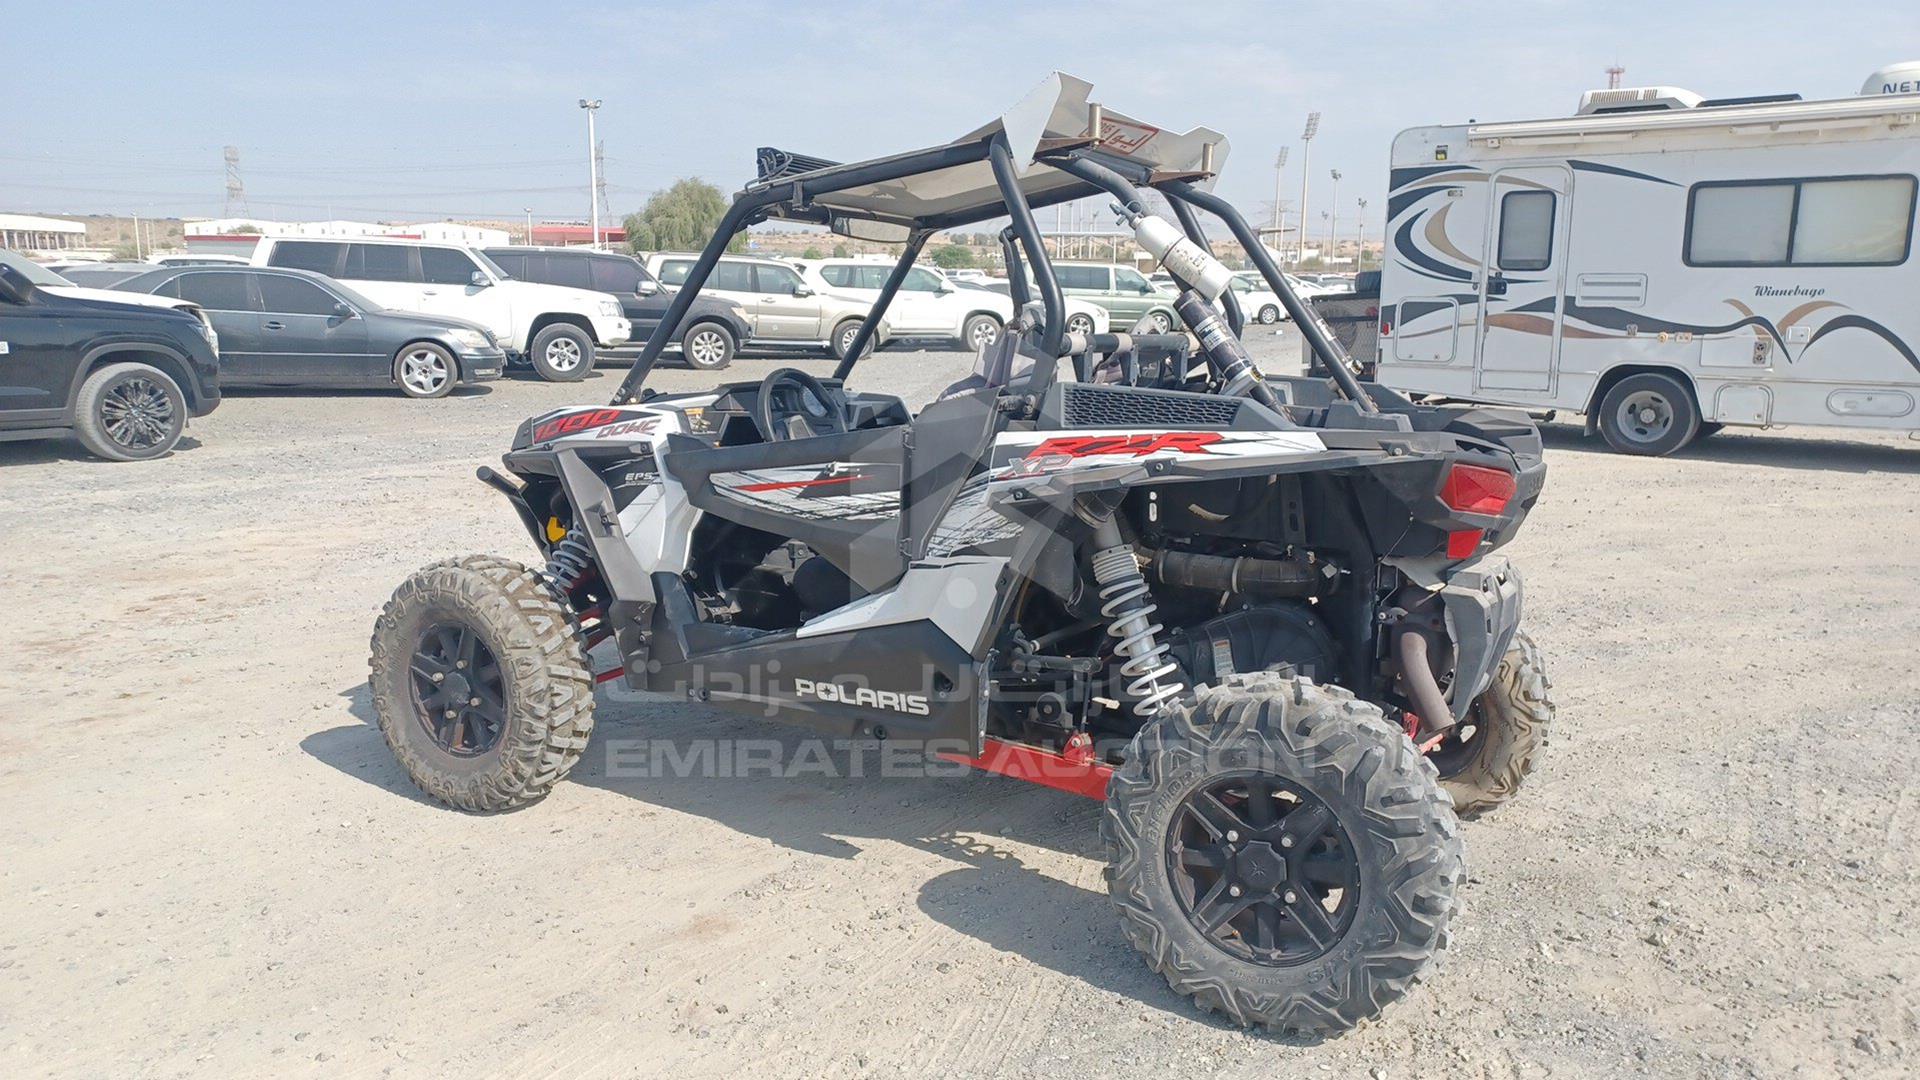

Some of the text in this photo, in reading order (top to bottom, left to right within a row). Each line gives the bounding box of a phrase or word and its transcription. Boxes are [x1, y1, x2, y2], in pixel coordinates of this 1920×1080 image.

[1753, 284, 1825, 298] Winnebago
[534, 408, 622, 443] 1000
[625, 472, 653, 481] EPS
[999, 455, 1074, 480] XP
[795, 678, 930, 716] POLARIS
